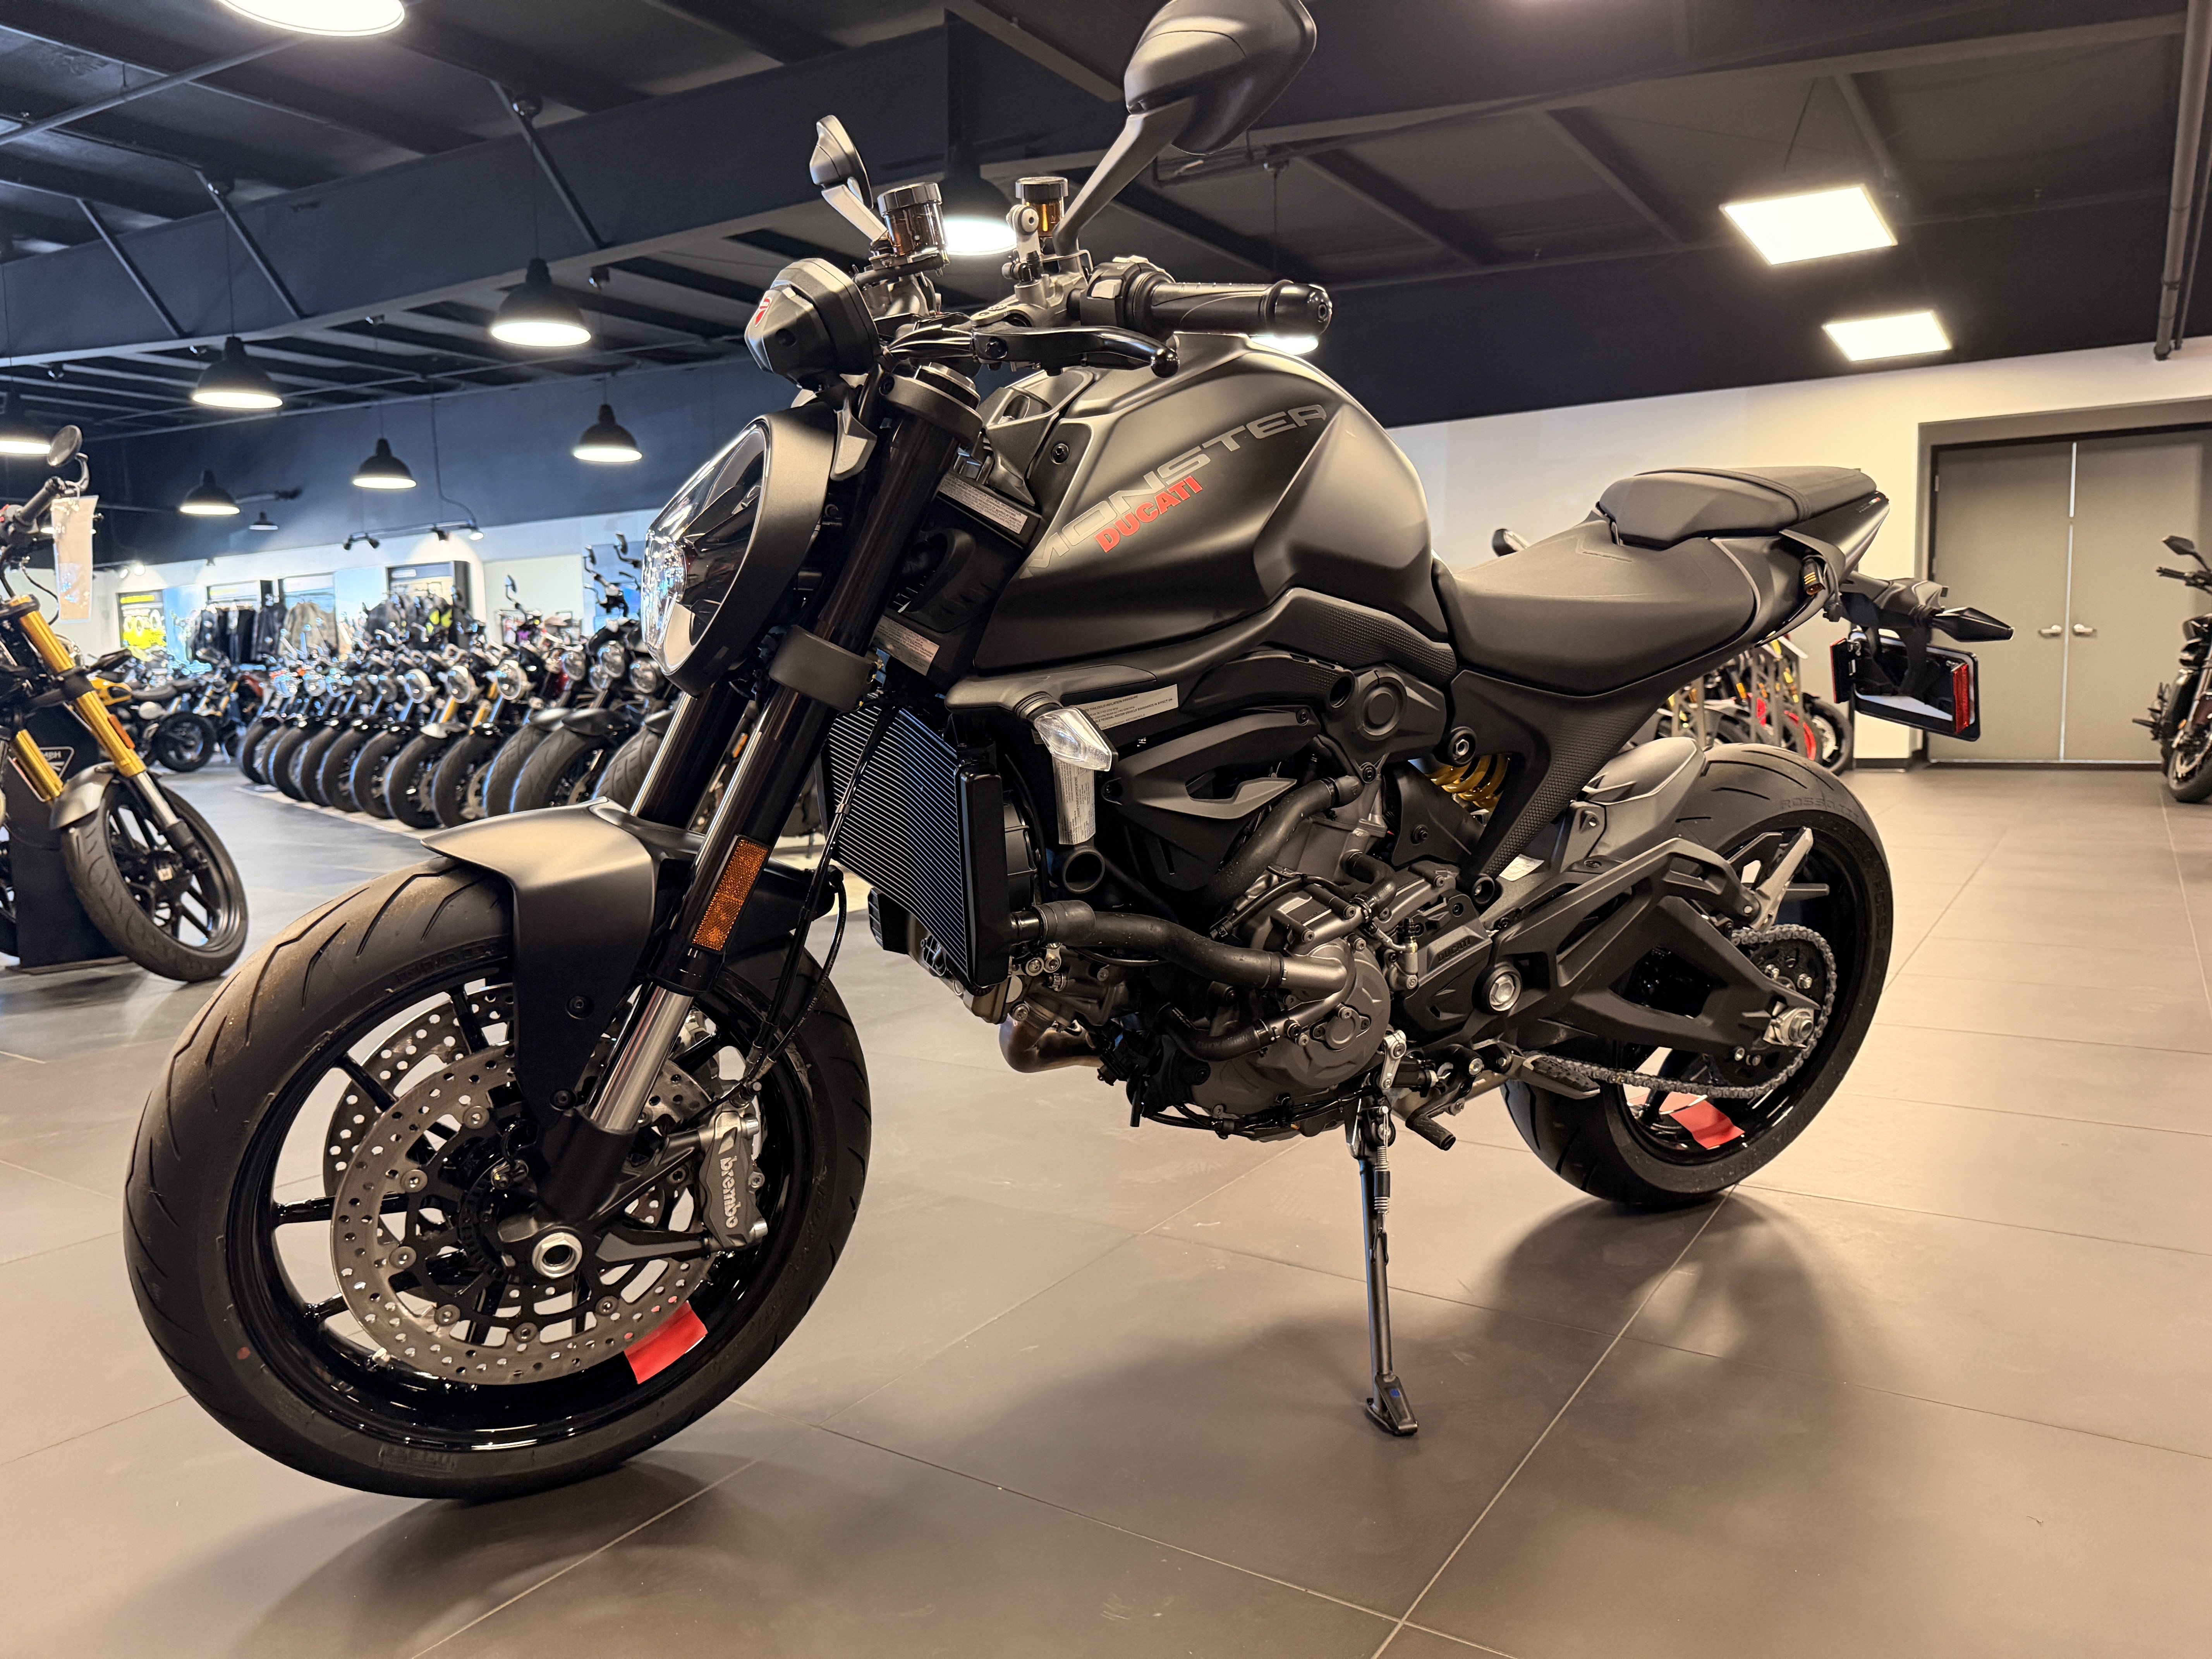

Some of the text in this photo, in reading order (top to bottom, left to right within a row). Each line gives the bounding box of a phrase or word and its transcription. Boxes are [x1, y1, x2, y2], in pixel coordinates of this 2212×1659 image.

[1019, 404, 1327, 579] MONSTER
[1094, 475, 1203, 553] DUCATI
[1437, 936, 1471, 963] DUCATI
[720, 1156, 741, 1228] brembo
